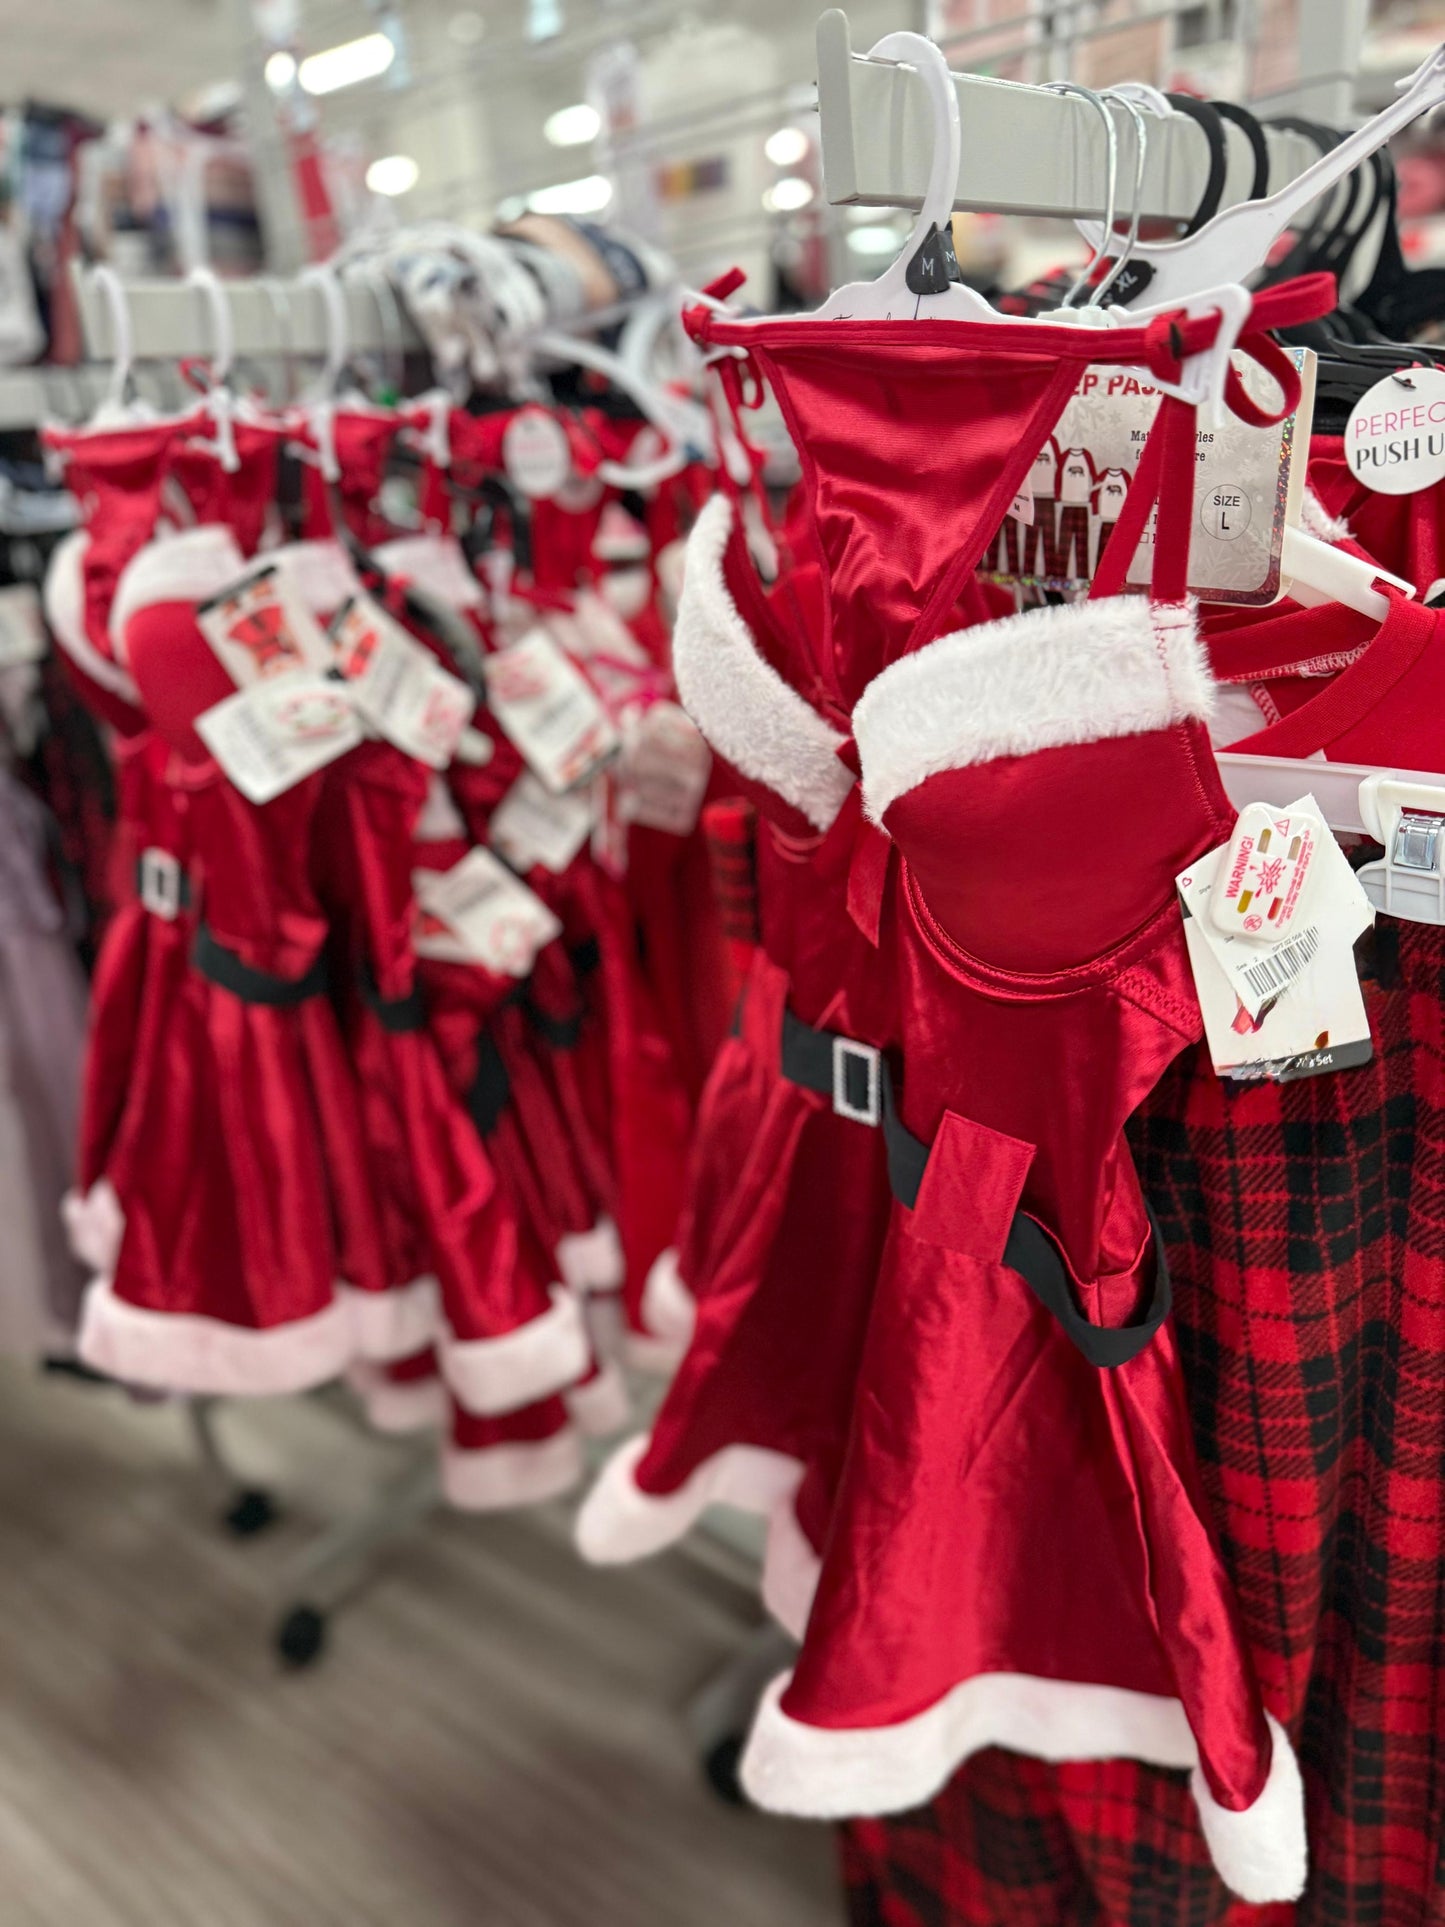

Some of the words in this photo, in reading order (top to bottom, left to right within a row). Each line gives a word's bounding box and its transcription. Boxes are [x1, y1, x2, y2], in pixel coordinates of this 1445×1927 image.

[945, 250, 956, 262] M
[921, 257, 934, 276] M
[1115, 270, 1139, 293] XL
[1356, 438, 1419, 471] PUSH
[1213, 495, 1240, 507] SIZE
[1221, 511, 1230, 530] L
[1225, 836, 1255, 898] WARNING!
